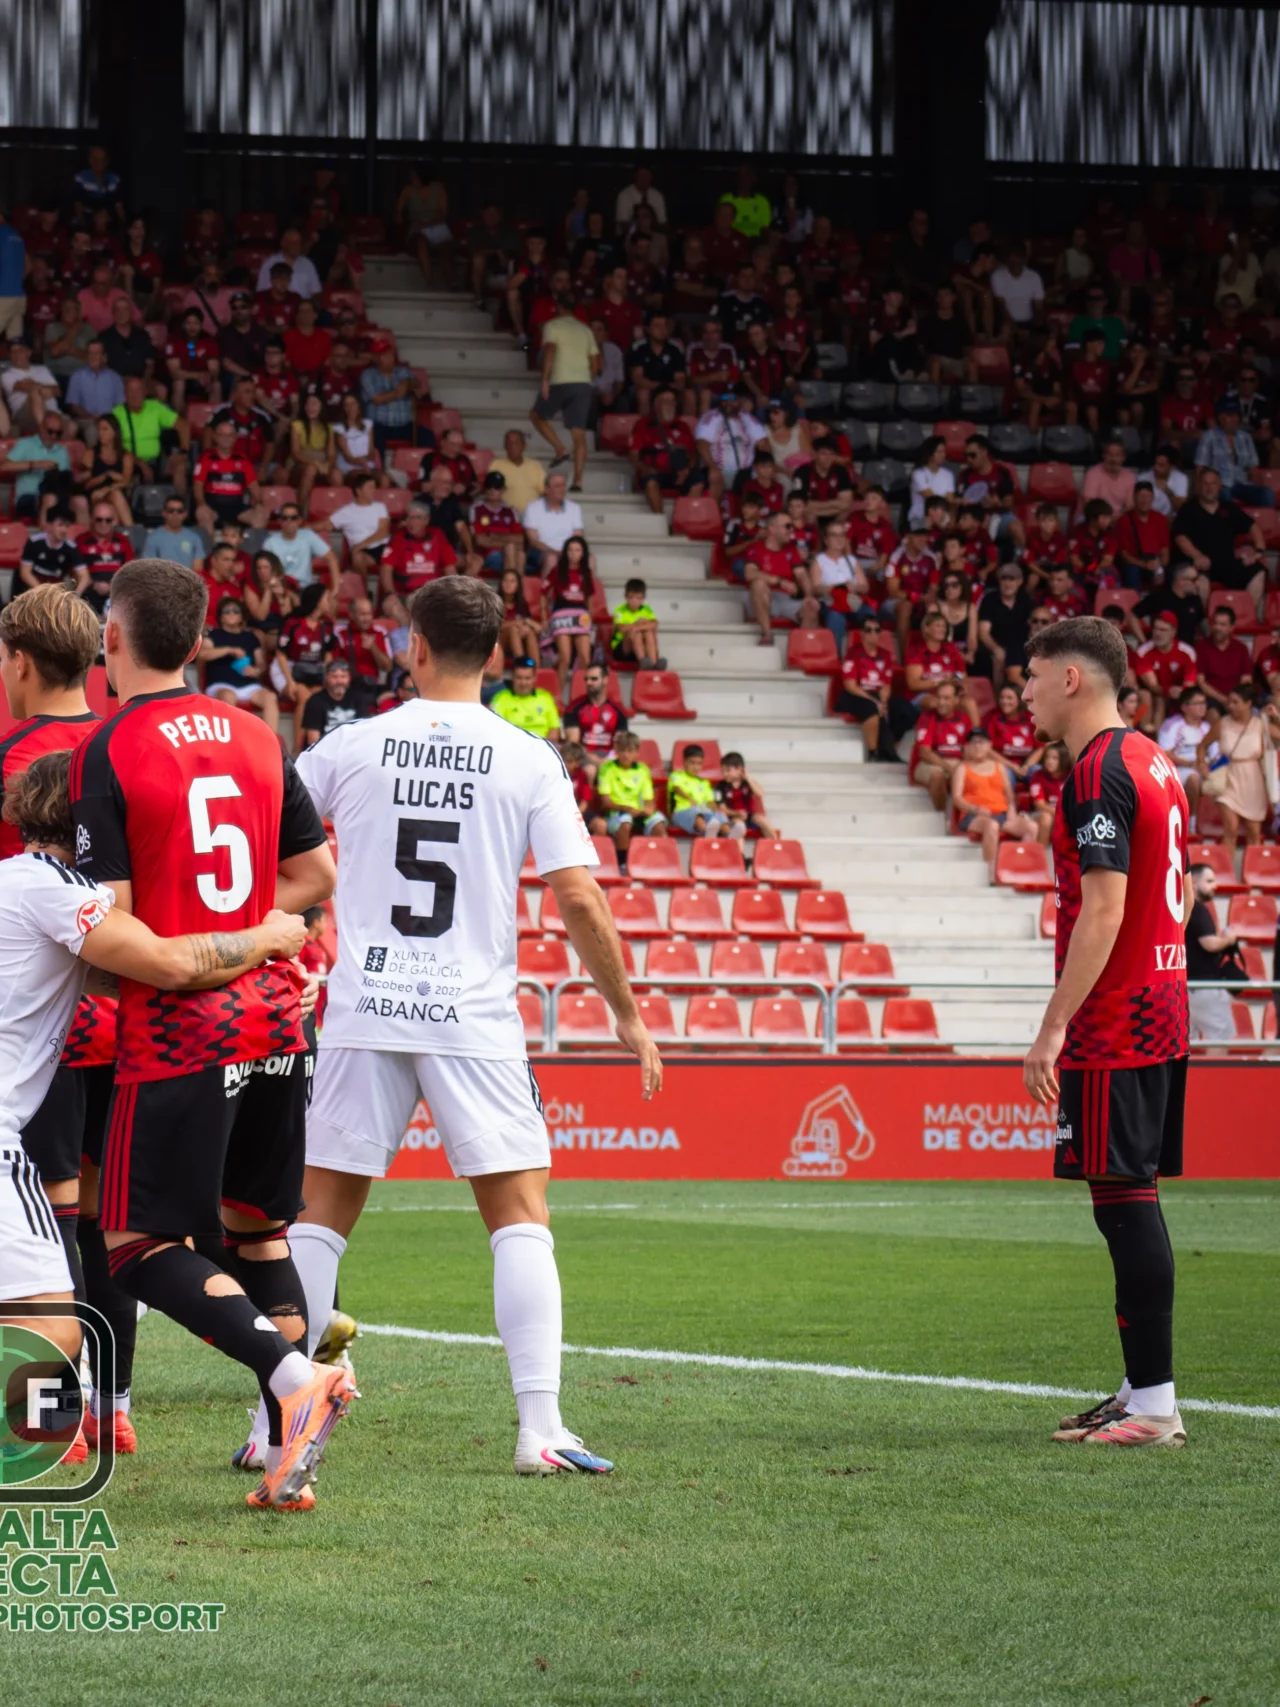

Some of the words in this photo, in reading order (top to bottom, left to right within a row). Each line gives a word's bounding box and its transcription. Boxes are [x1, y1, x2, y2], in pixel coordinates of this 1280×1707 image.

[158, 714, 232, 749] PERU
[428, 734, 452, 743] VERMUT
[381, 738, 494, 775] POVARELO
[393, 777, 475, 810] LUCAS
[187, 775, 254, 915] 5
[390, 817, 461, 939] 5
[392, 950, 438, 963] XUNTA
[388, 963, 406, 974] DE
[410, 964, 463, 980] GALICIA
[361, 975, 413, 994] Xacobeo
[435, 985, 462, 997] 2027
[923, 1127, 962, 1151] DE
[967, 1127, 1056, 1151] OCASI
